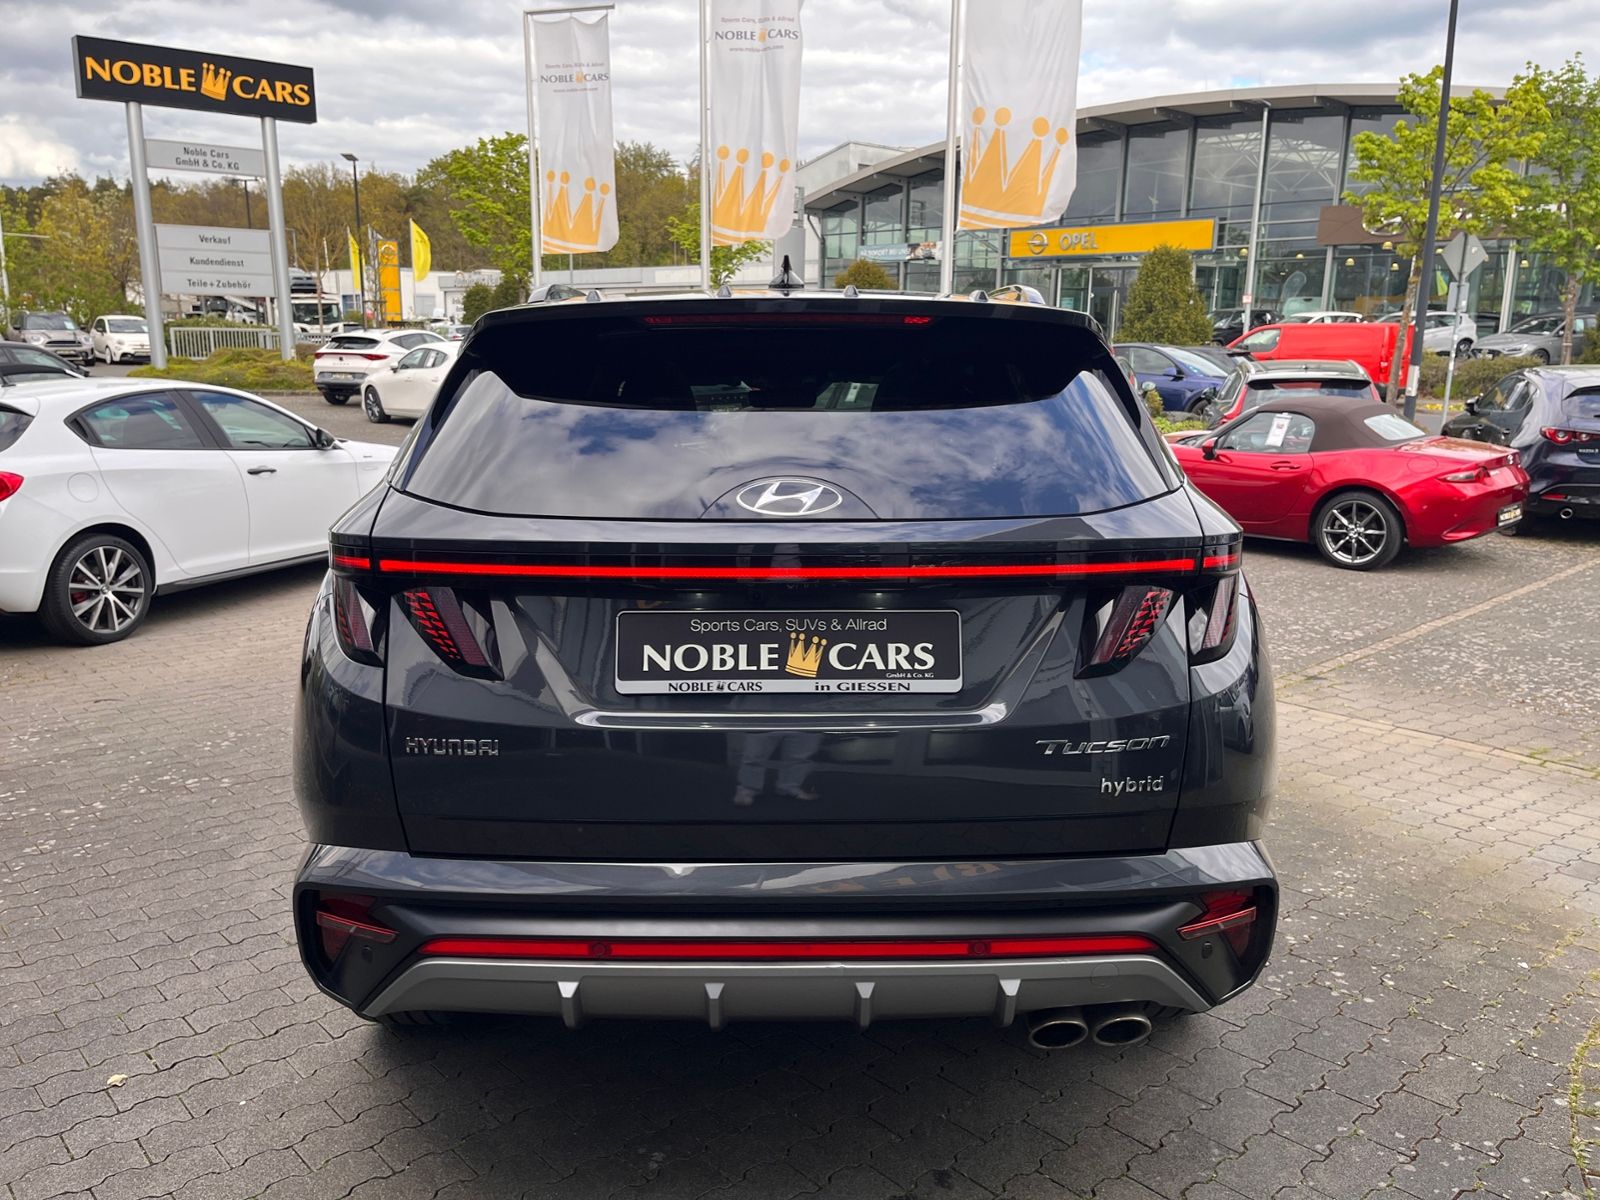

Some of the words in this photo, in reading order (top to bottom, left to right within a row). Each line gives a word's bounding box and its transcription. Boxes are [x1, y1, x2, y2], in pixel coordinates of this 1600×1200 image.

[714, 30, 756, 40] NOBLE
[767, 28, 799, 40] CARS
[85, 56, 197, 92] NOBLE
[232, 75, 311, 106] CARS
[540, 74, 574, 83] NOBLE
[583, 72, 609, 82] CARS
[183, 147, 208, 157] Noble
[210, 149, 230, 160] Cars
[175, 156, 200, 167] GmbH
[202, 159, 209, 168] &
[211, 160, 226, 170] Co.
[227, 161, 240, 171] KG
[198, 234, 231, 245] Verkauf
[1059, 232, 1099, 251] OPEL
[189, 256, 244, 268] Kundendienst
[690, 618, 740, 634] Sports
[743, 618, 782, 632] Cars,
[785, 618, 827, 631] SUVs
[830, 618, 842, 631] &
[845, 618, 887, 631] Allrad
[642, 643, 780, 672] NOBLE
[828, 642, 936, 671] CARS
[668, 682, 714, 692] NOBLE
[727, 681, 763, 692] CARS
[815, 682, 830, 691] in
[836, 682, 911, 692] GIESSEN
[406, 737, 499, 756] HYUNDAI
[1101, 775, 1164, 796] hybrid
